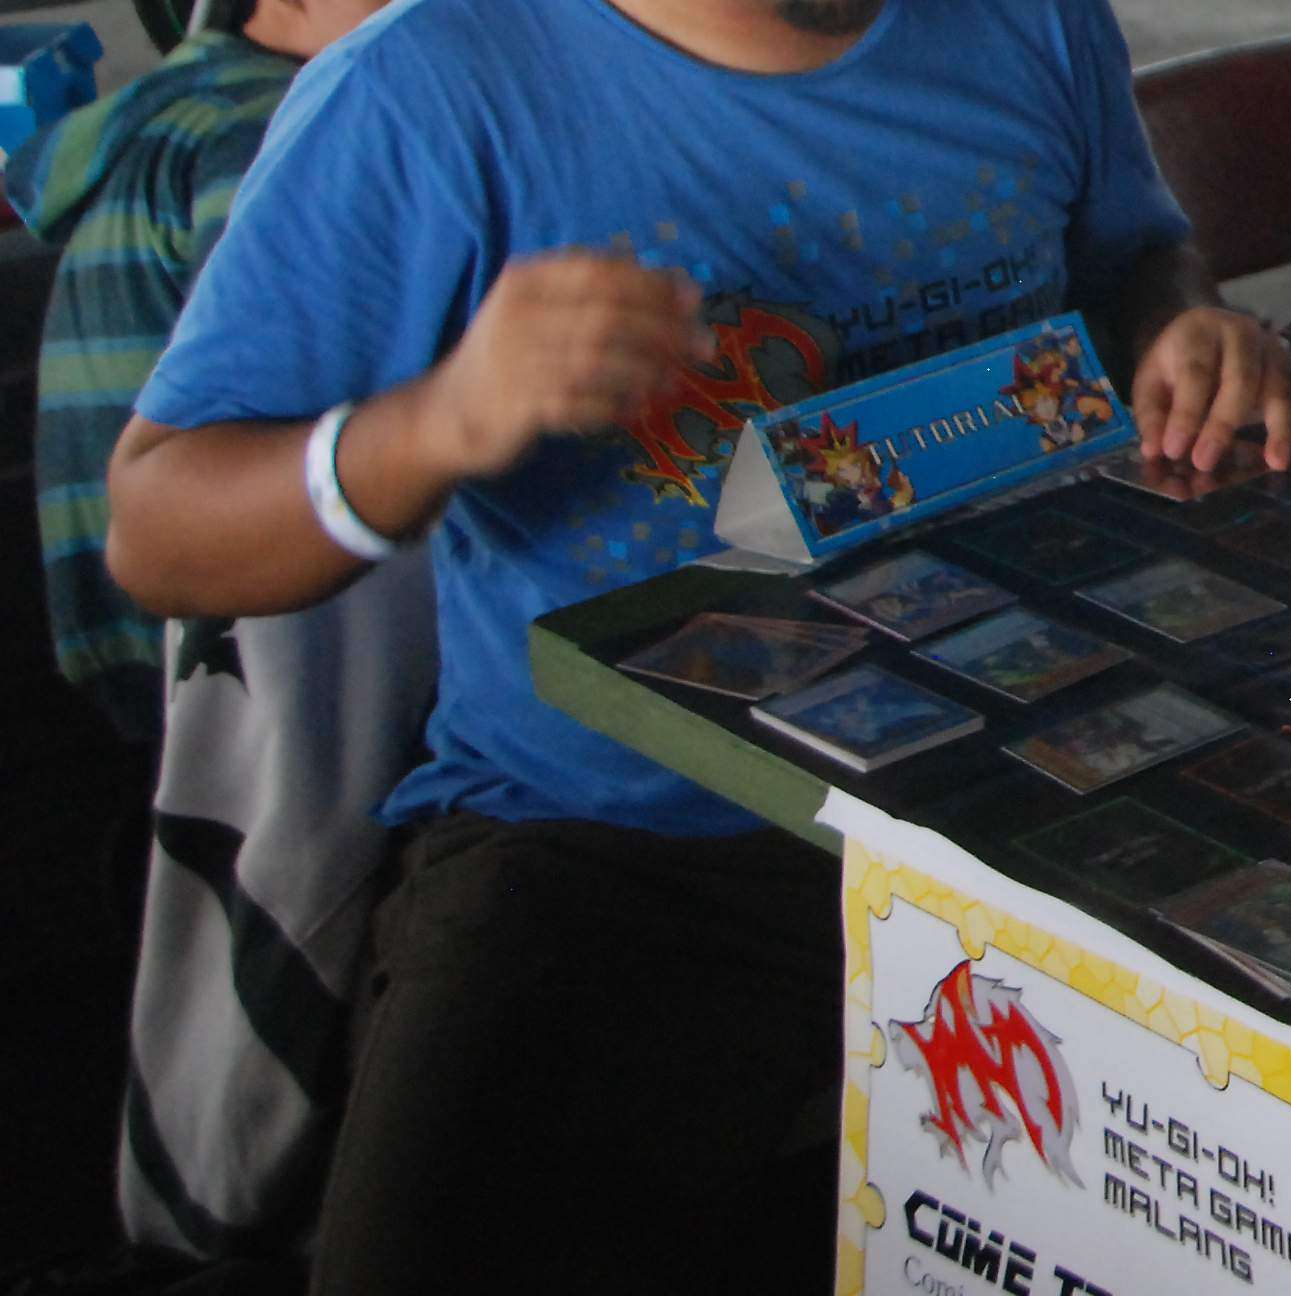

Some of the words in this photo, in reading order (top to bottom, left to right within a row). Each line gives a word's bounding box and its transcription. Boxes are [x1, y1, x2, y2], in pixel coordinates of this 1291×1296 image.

[1101, 1080, 1276, 1208] YU-GI-OH!
[1103, 1125, 1200, 1210] META
[904, 1188, 1038, 1296] COME
[1103, 1171, 1254, 1286] MALANG
